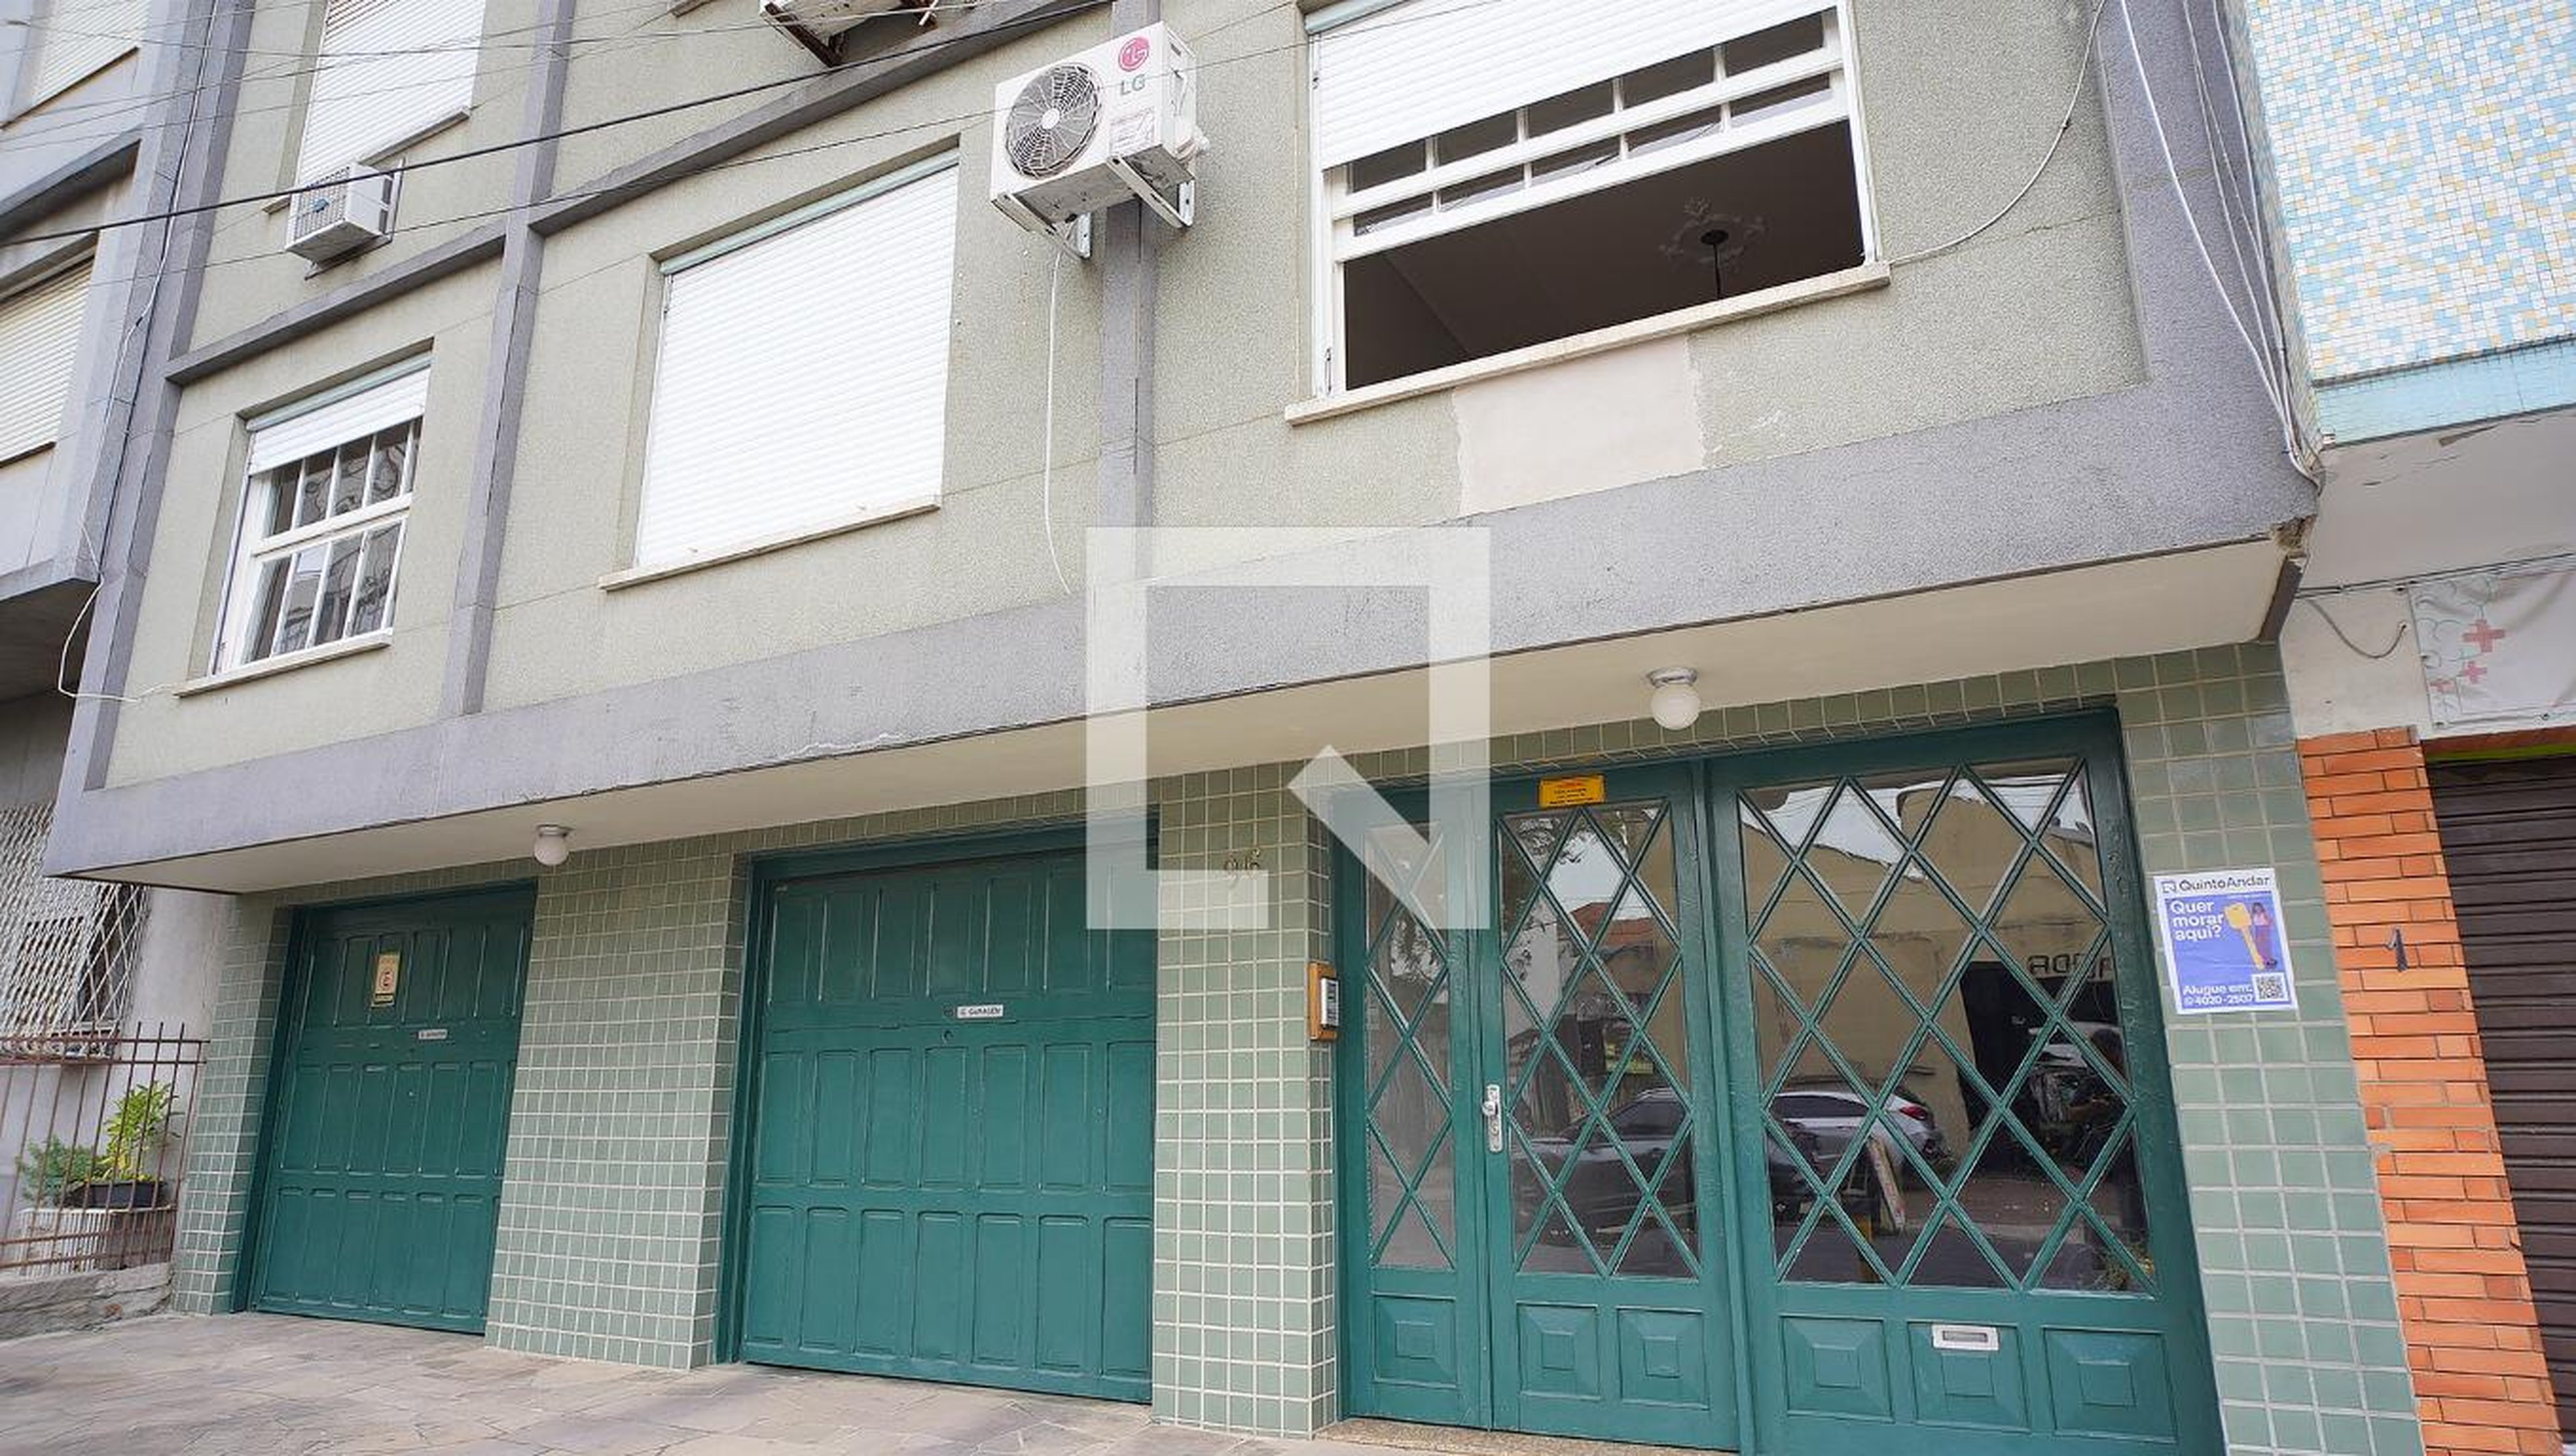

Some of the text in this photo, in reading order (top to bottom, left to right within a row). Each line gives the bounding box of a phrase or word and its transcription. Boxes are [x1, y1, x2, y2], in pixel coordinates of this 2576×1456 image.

[1120, 74, 1146, 95] LG
[2180, 876, 2270, 891] QuintoAndar
[2171, 900, 2214, 915] Quer
[2174, 914, 2224, 927] morar
[2175, 925, 2222, 942] aqui?
